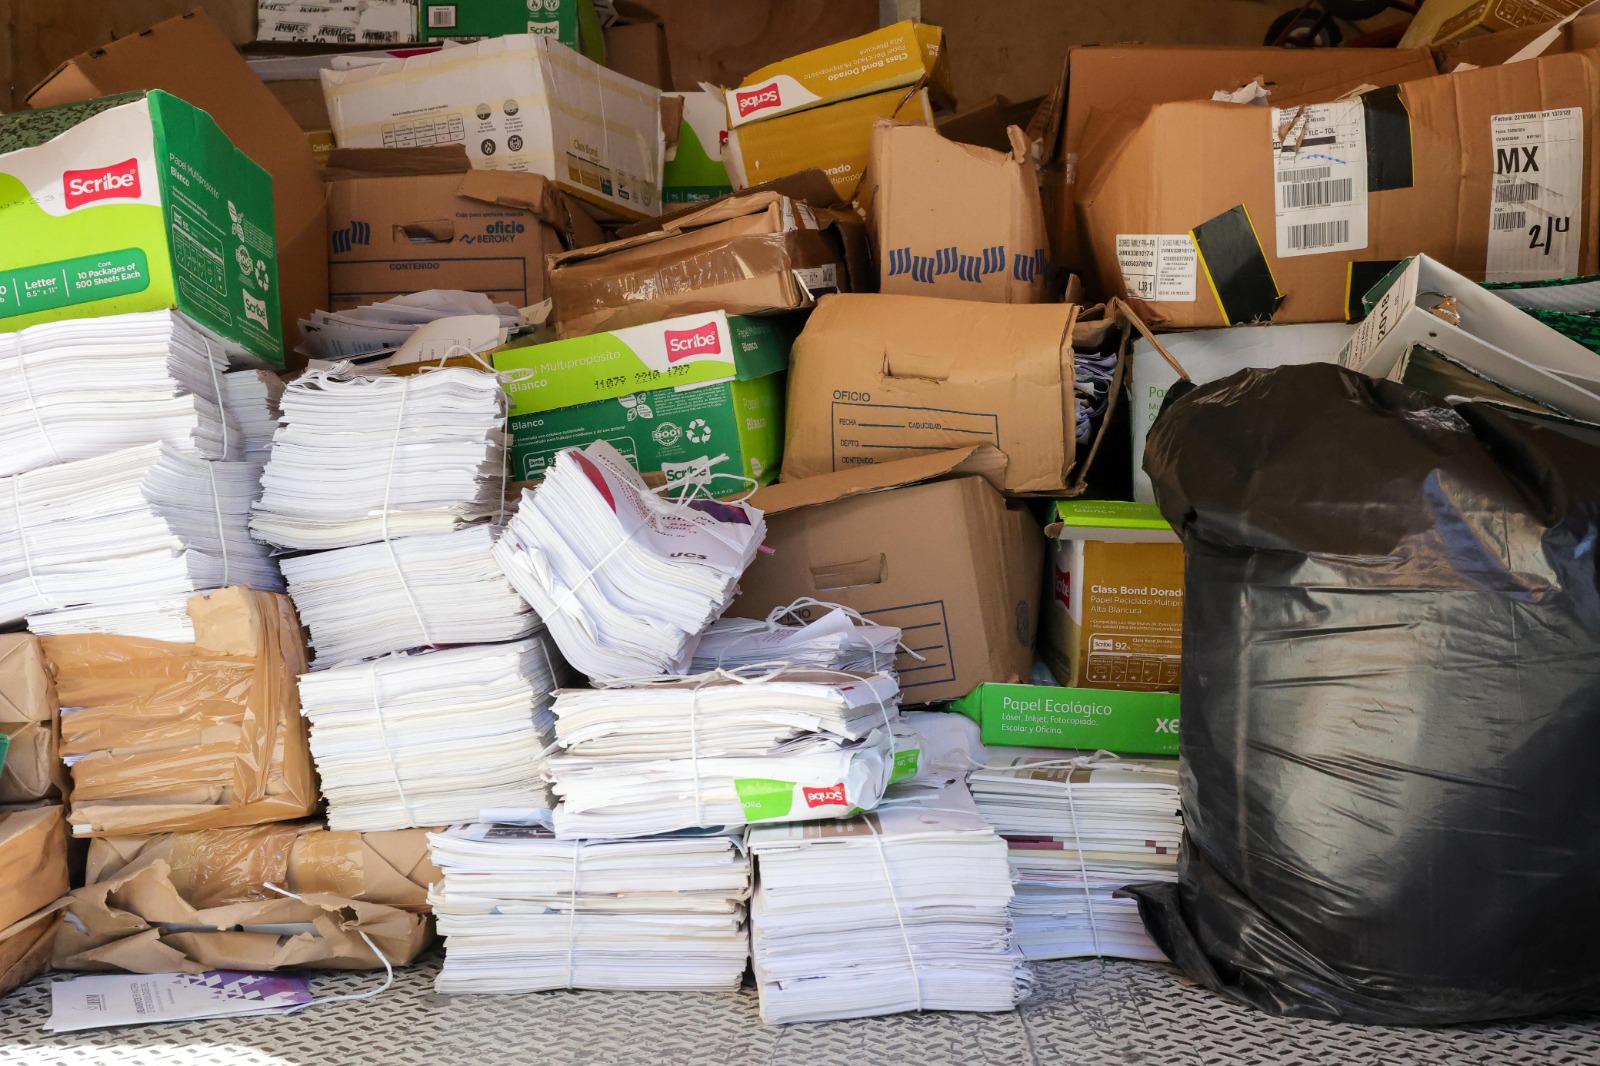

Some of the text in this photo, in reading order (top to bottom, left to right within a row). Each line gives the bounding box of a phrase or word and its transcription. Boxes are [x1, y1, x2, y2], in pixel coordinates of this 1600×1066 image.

[530, 25, 557, 34] Scribe
[859, 37, 904, 56] Alta Blancura
[886, 44, 906, 55] Papel
[853, 51, 886, 65] Reciclado
[828, 52, 908, 82] Class Bond Dorado
[740, 89, 778, 109] Scribe
[1497, 146, 1539, 174] MX
[825, 164, 851, 176] orado
[170, 166, 190, 187] Blanco
[69, 172, 135, 196] Scribe
[486, 221, 524, 234] oficio
[477, 234, 515, 244] BEROKY
[78, 262, 136, 280] 10 Packages of
[389, 262, 440, 270] CONTENIDO
[24, 278, 56, 290] Letter
[76, 270, 140, 289] 500 Sheets Each
[246, 298, 266, 321] Scribe
[1378, 294, 1390, 341] 2018
[670, 334, 716, 352] Scribe
[540, 350, 620, 374] Multipropósito
[509, 378, 548, 393] Blanco
[832, 390, 871, 402] OFICIO
[512, 419, 544, 430] Blanco
[839, 418, 942, 430] FECHA CADUCIDAD
[654, 428, 681, 439] 9001
[840, 440, 860, 448] DEPTO.
[841, 456, 874, 464] CONTENIDO
[1091, 584, 1118, 594] Class
[1120, 586, 1148, 596] Bond
[1091, 596, 1112, 605] Papel
[1116, 596, 1151, 606] Reciclado
[1108, 606, 1142, 614] Blancura
[1002, 696, 1112, 718] Papel Ecológico
[1002, 724, 1028, 732] Escolar
[1036, 726, 1064, 734] Oficina.
[1155, 717, 1180, 734] xe
[808, 791, 843, 802] Scribe
